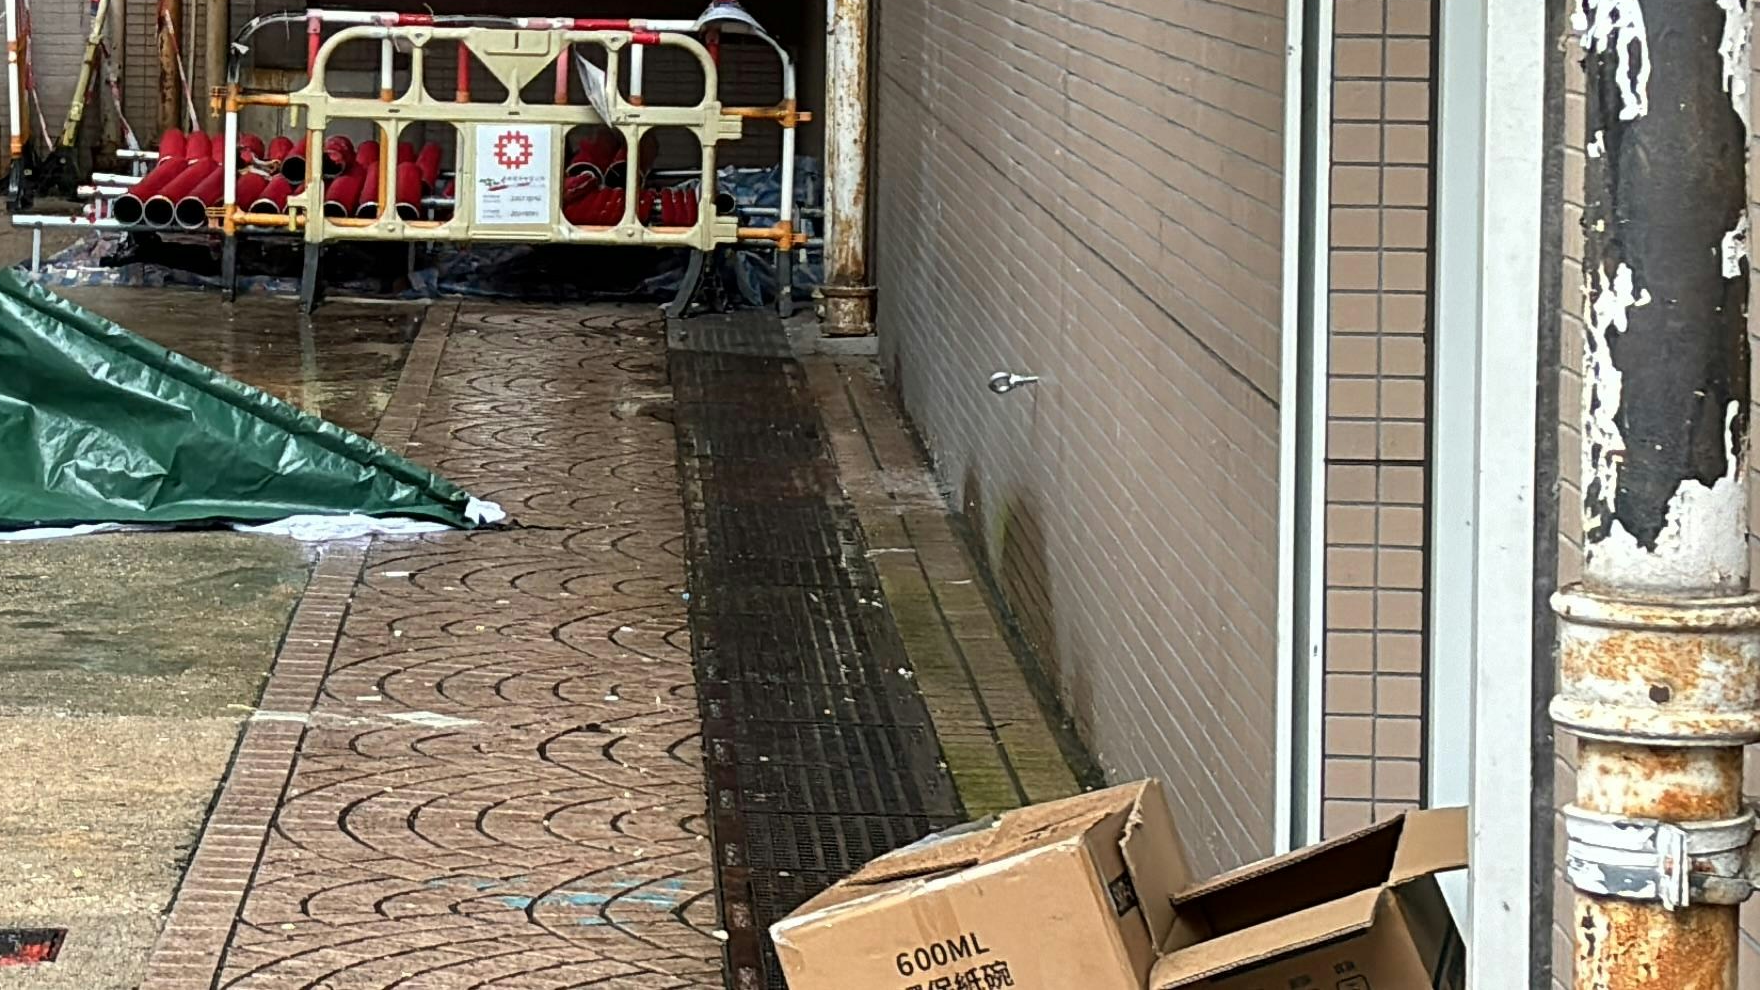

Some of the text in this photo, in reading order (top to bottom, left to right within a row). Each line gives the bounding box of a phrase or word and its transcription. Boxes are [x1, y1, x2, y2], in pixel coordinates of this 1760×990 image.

[896, 932, 990, 976] 600ML
[905, 960, 1015, 990] 保紙碗
